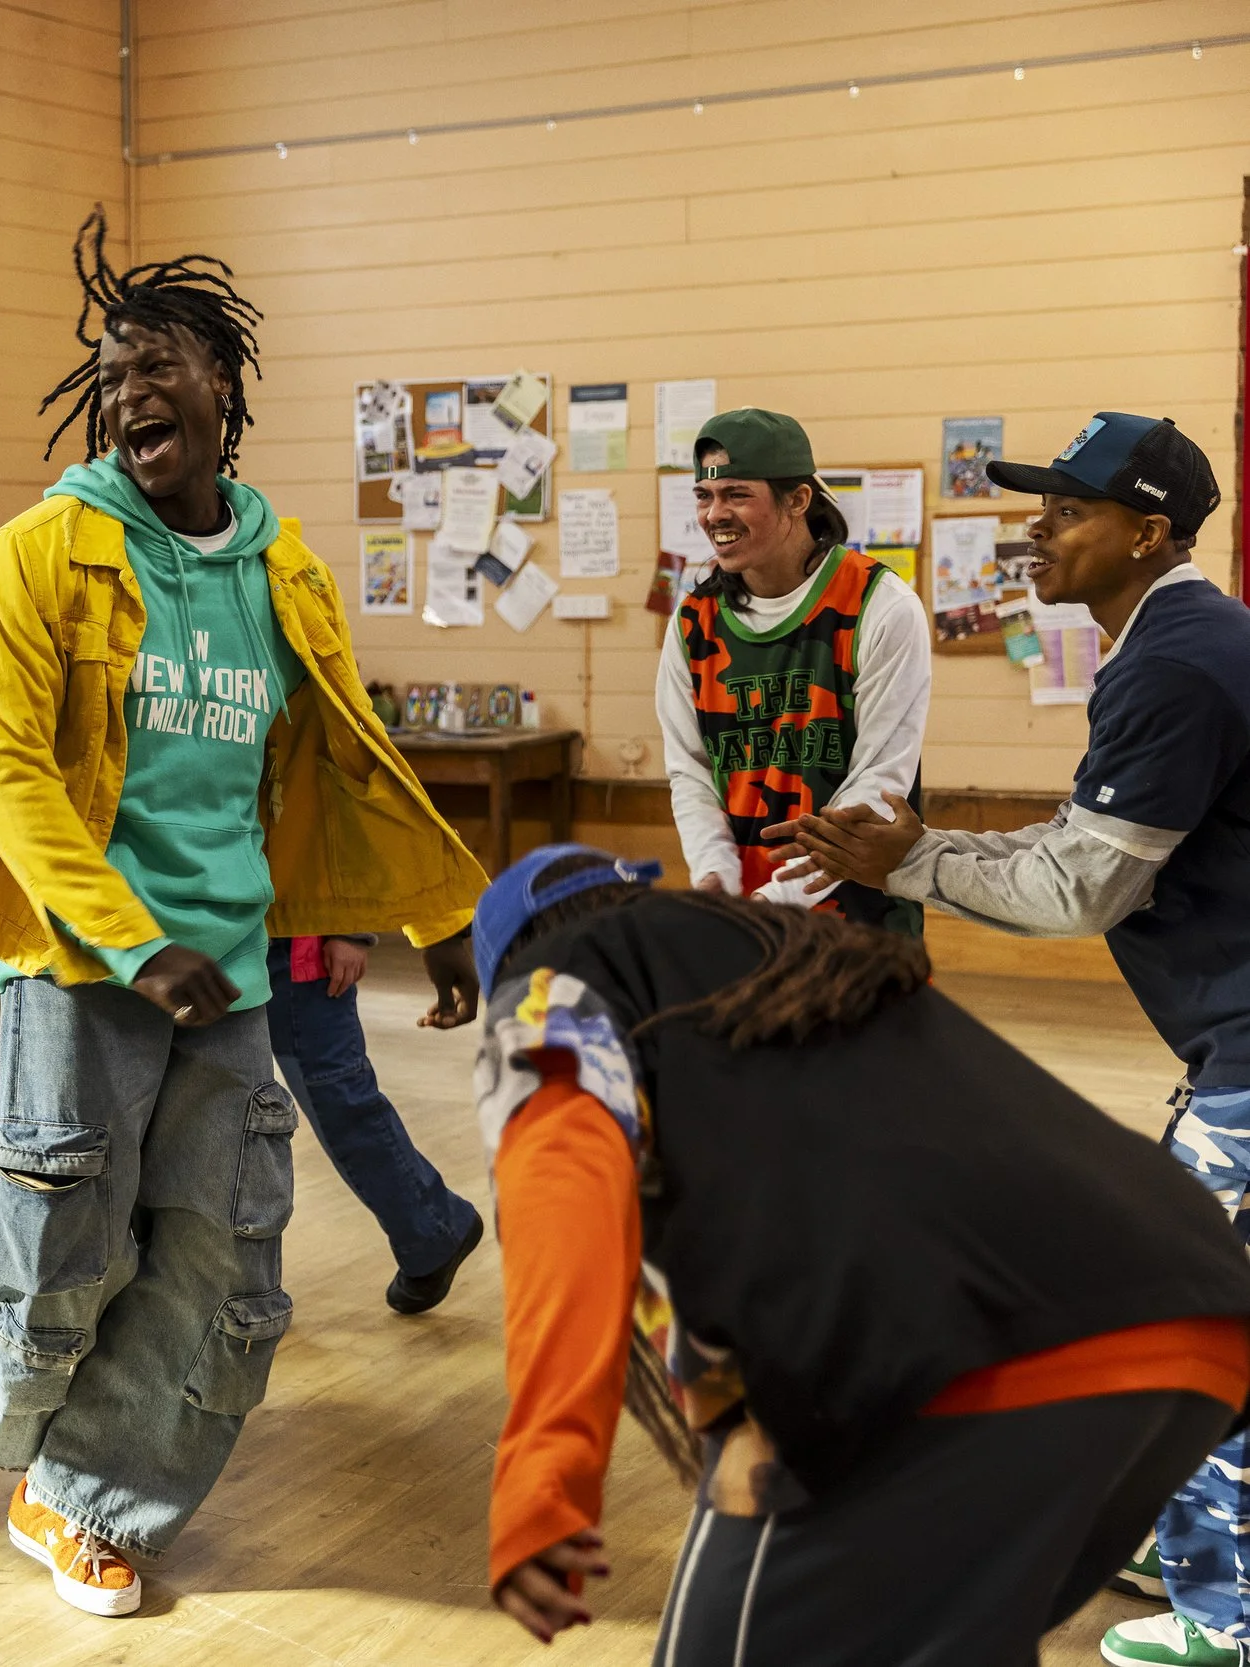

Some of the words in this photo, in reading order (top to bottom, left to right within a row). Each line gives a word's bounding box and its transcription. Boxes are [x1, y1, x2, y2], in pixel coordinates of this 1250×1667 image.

[188, 630, 209, 662] IN
[125, 651, 185, 694] NEW
[199, 667, 270, 714] YORK
[726, 668, 815, 722] THE
[135, 697, 146, 729] I
[146, 697, 199, 736] MILLY
[202, 701, 257, 745] ROCK
